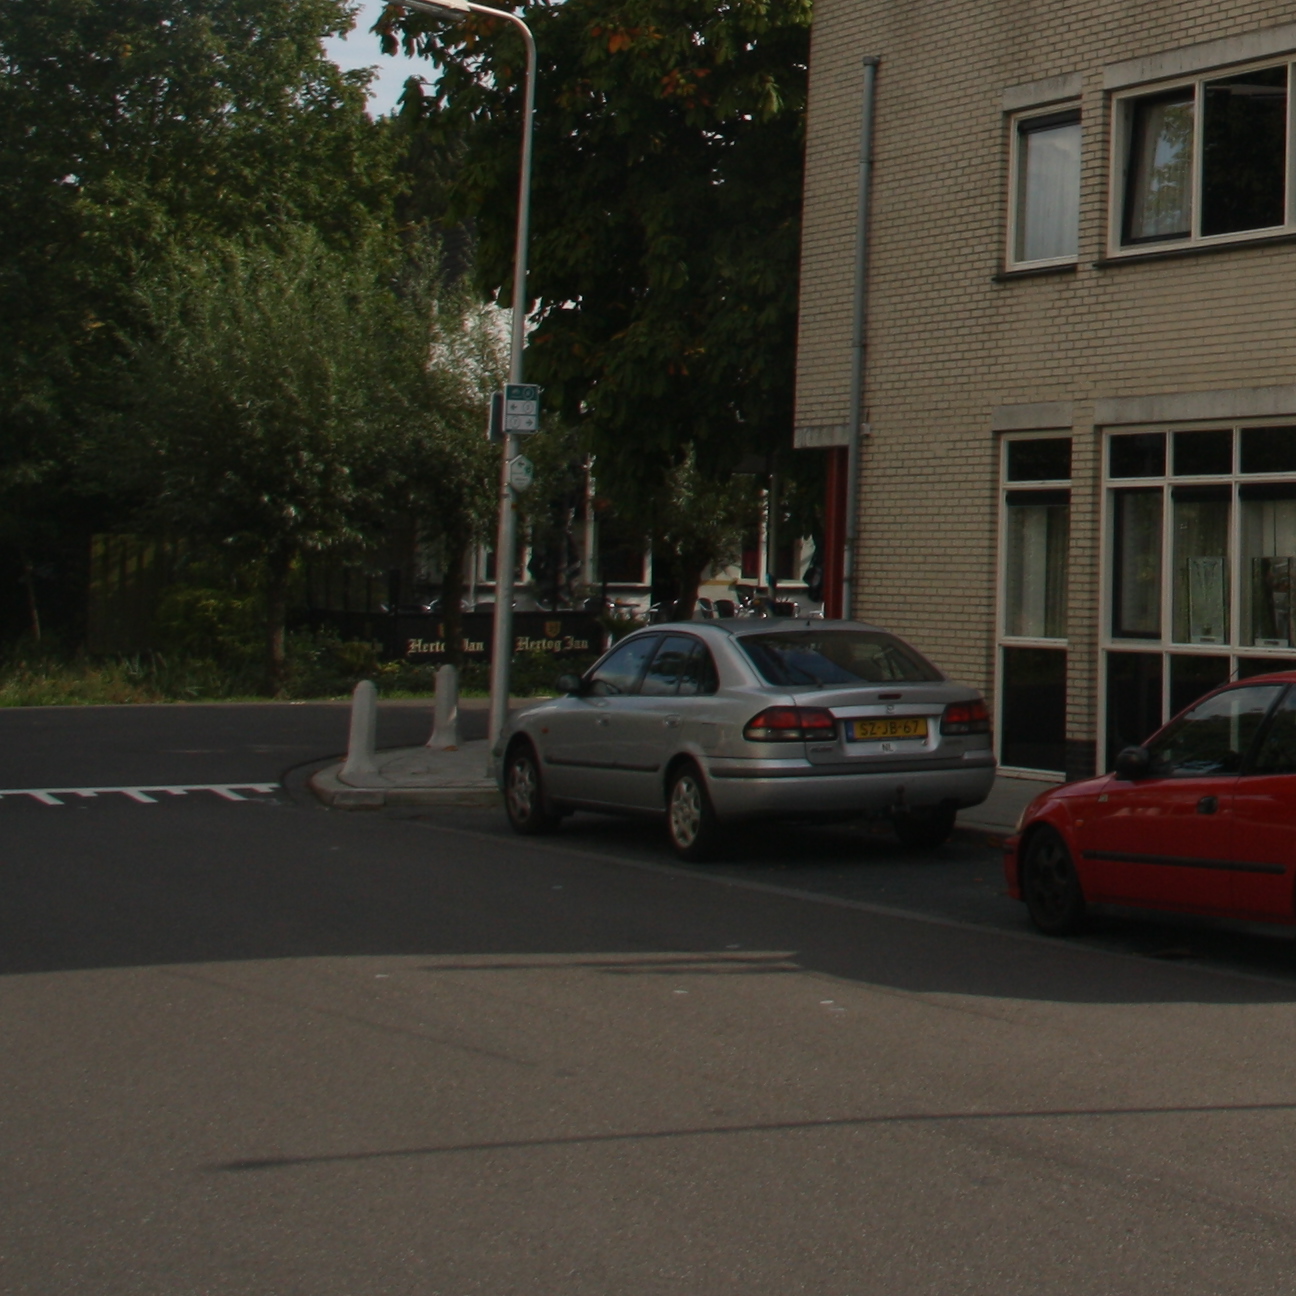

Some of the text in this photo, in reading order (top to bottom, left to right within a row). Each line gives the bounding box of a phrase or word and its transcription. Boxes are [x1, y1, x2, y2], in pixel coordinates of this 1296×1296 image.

[407, 638, 446, 655] Hert
[515, 635, 589, 653] Hertog Jan
[860, 720, 919, 736] SZ-JB-67
[881, 743, 894, 752] NL
